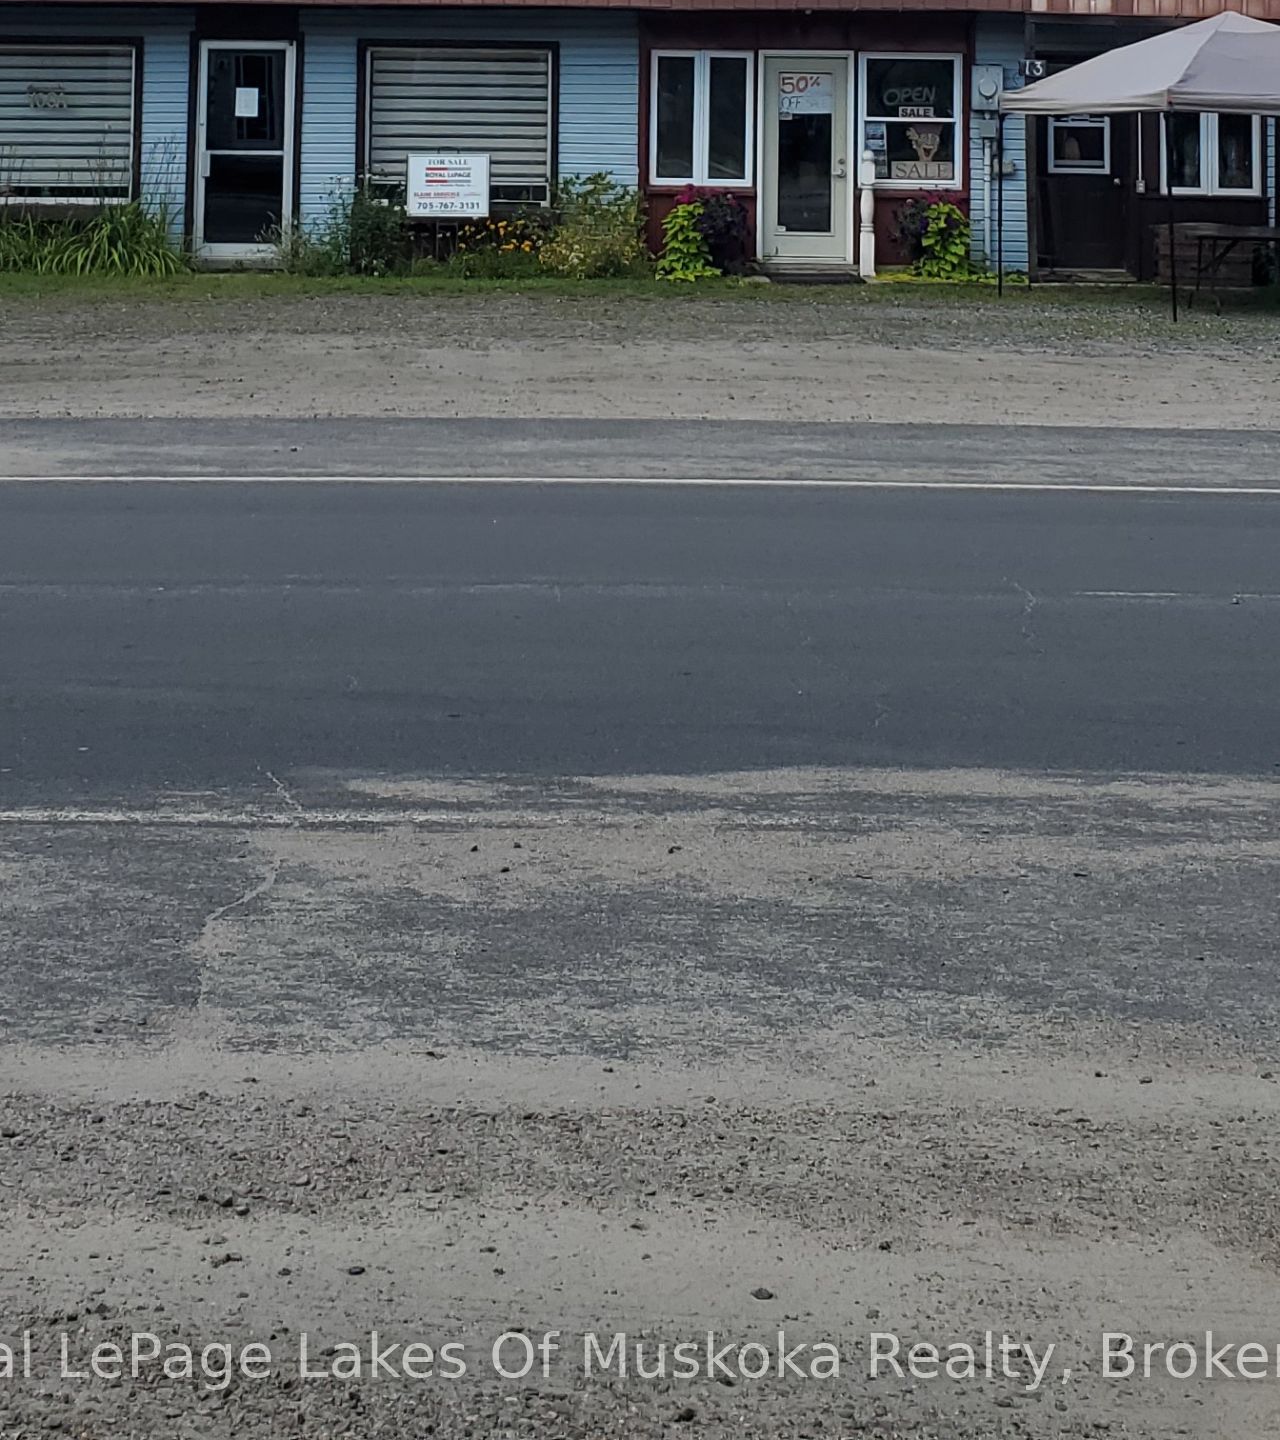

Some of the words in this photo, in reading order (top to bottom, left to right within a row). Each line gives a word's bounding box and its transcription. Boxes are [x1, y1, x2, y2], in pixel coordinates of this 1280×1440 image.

[780, 75, 821, 94] 50%
[883, 86, 936, 107] OPEN
[901, 108, 932, 117] SALE
[895, 162, 950, 178] SALE
